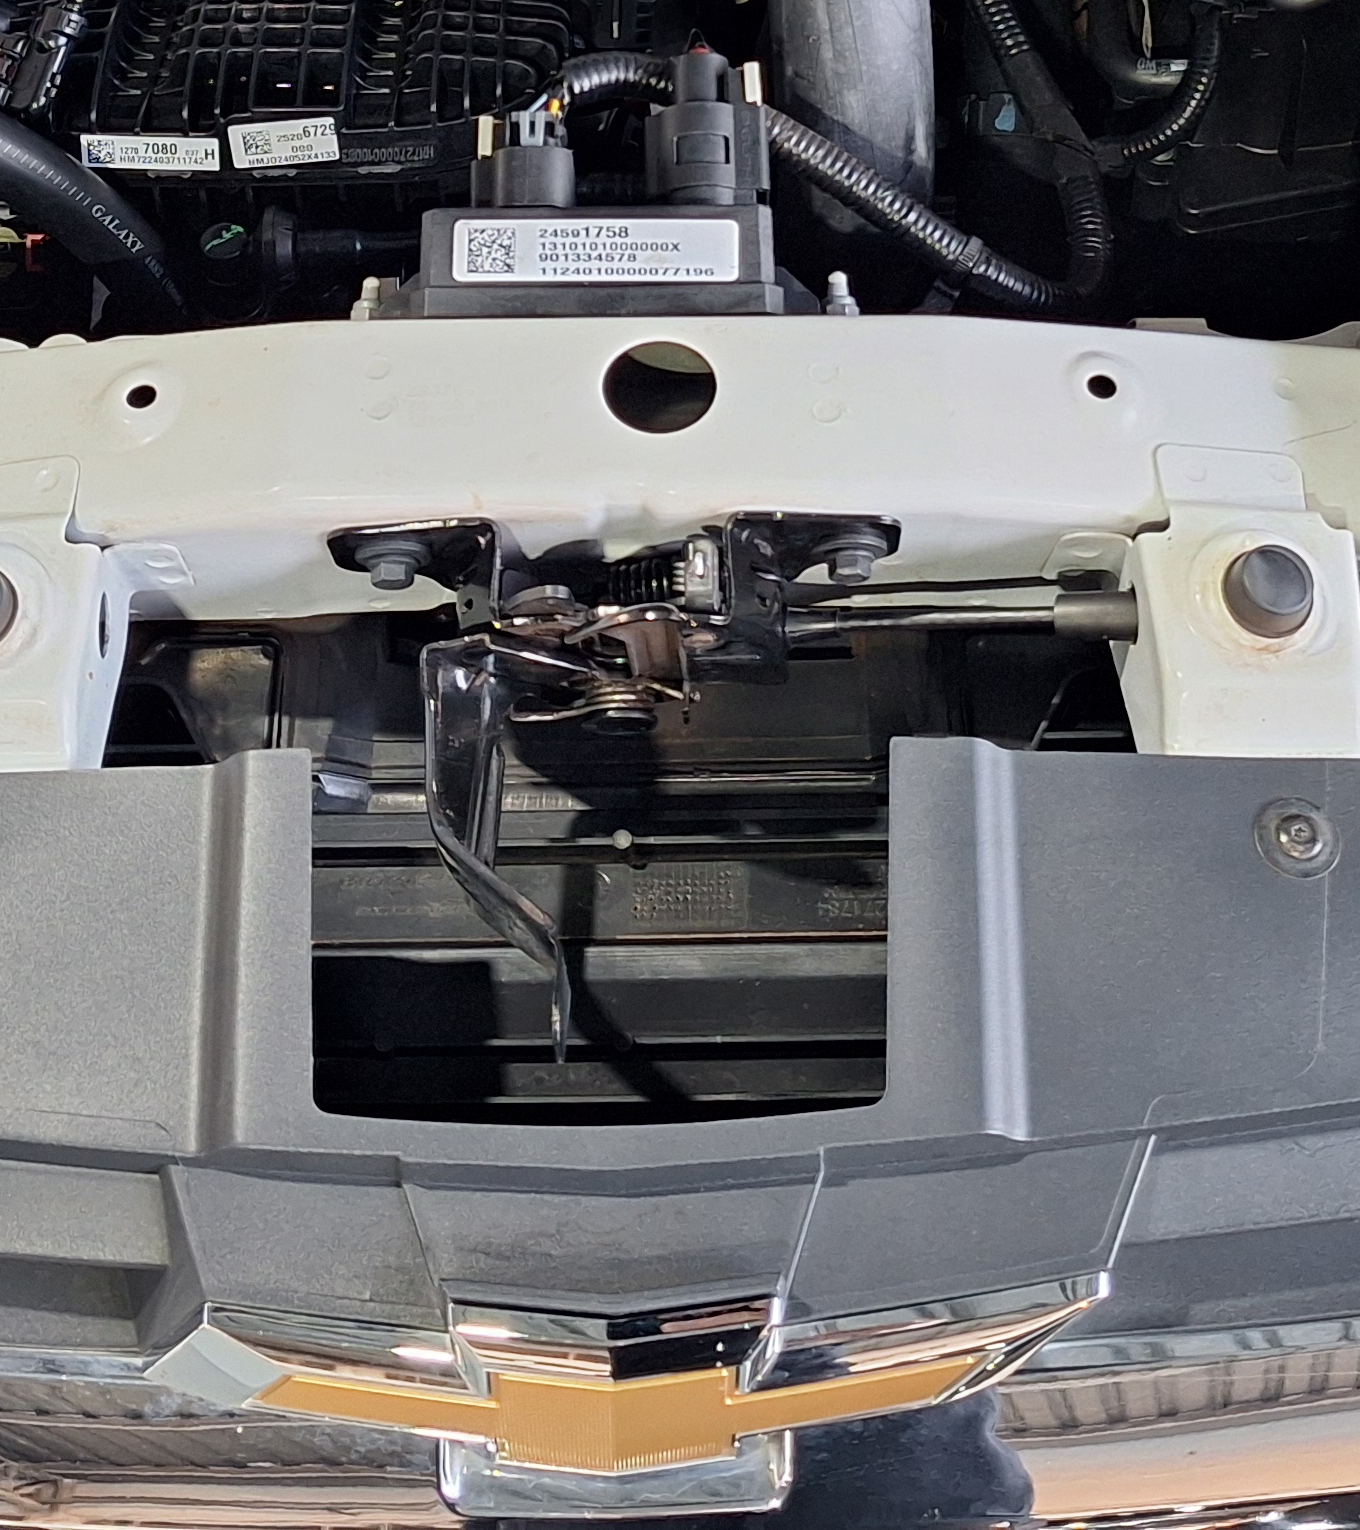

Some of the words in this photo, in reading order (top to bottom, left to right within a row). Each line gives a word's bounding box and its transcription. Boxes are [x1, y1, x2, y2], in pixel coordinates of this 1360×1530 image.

[142, 142, 178, 156] 7080
[204, 148, 216, 161] H
[91, 204, 146, 254] GALAXY
[538, 226, 629, 239] 24591758
[538, 242, 682, 252] 1310101000000X
[538, 253, 637, 263] 901334578
